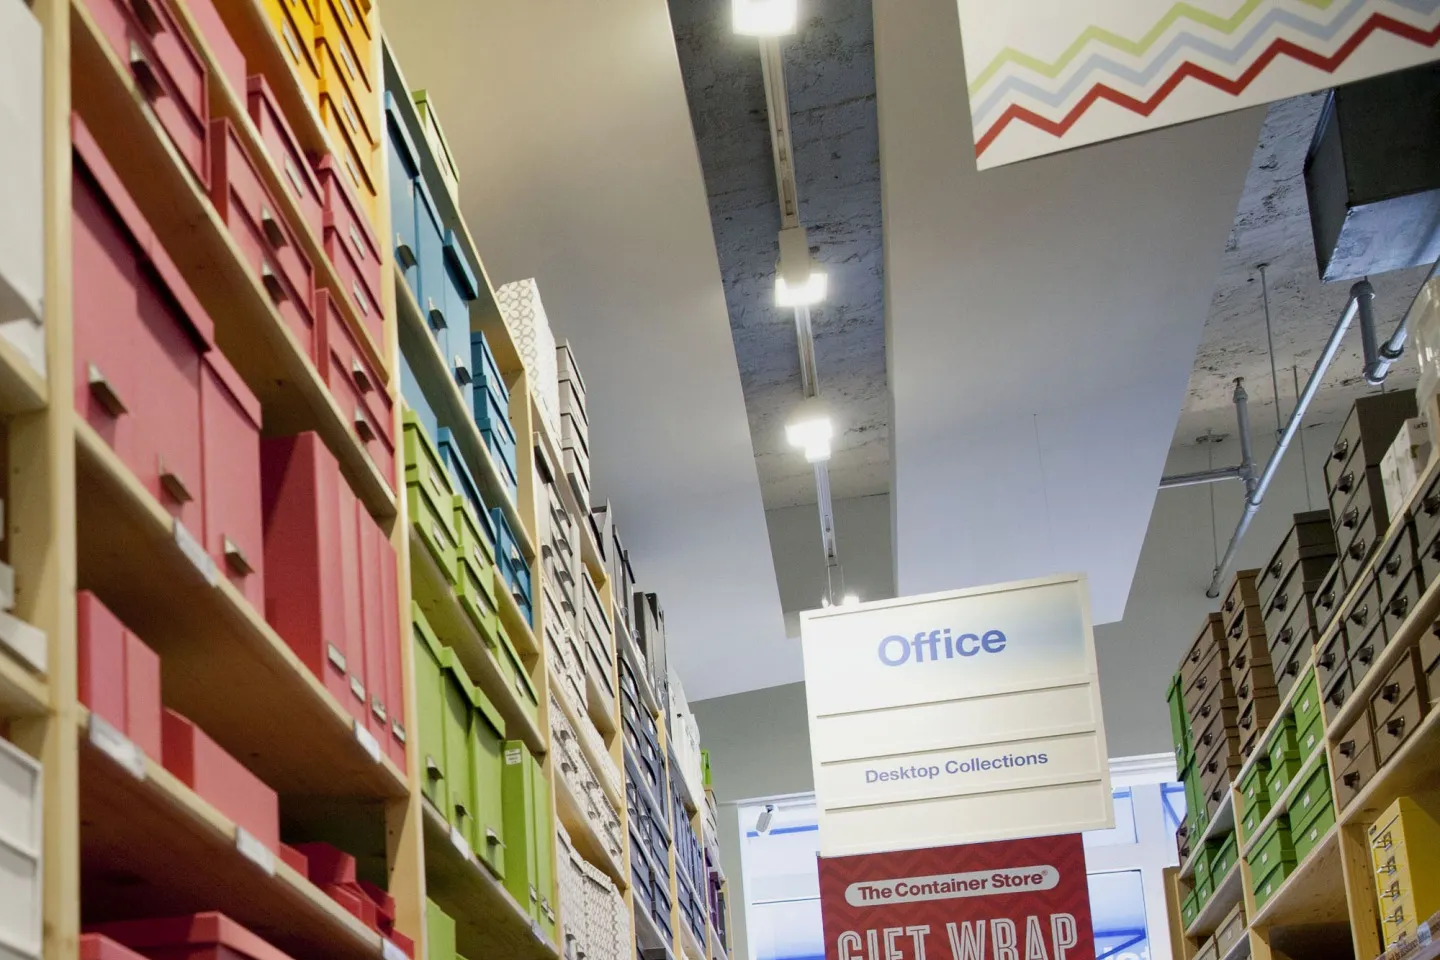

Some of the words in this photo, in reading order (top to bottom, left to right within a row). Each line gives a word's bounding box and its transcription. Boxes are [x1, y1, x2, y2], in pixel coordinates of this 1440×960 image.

[878, 628, 1007, 667] Office
[865, 764, 940, 784] Desktop
[945, 752, 1049, 775] Collections
[857, 885, 893, 901] The
[894, 877, 989, 898] Container
[991, 872, 1044, 889] Store
